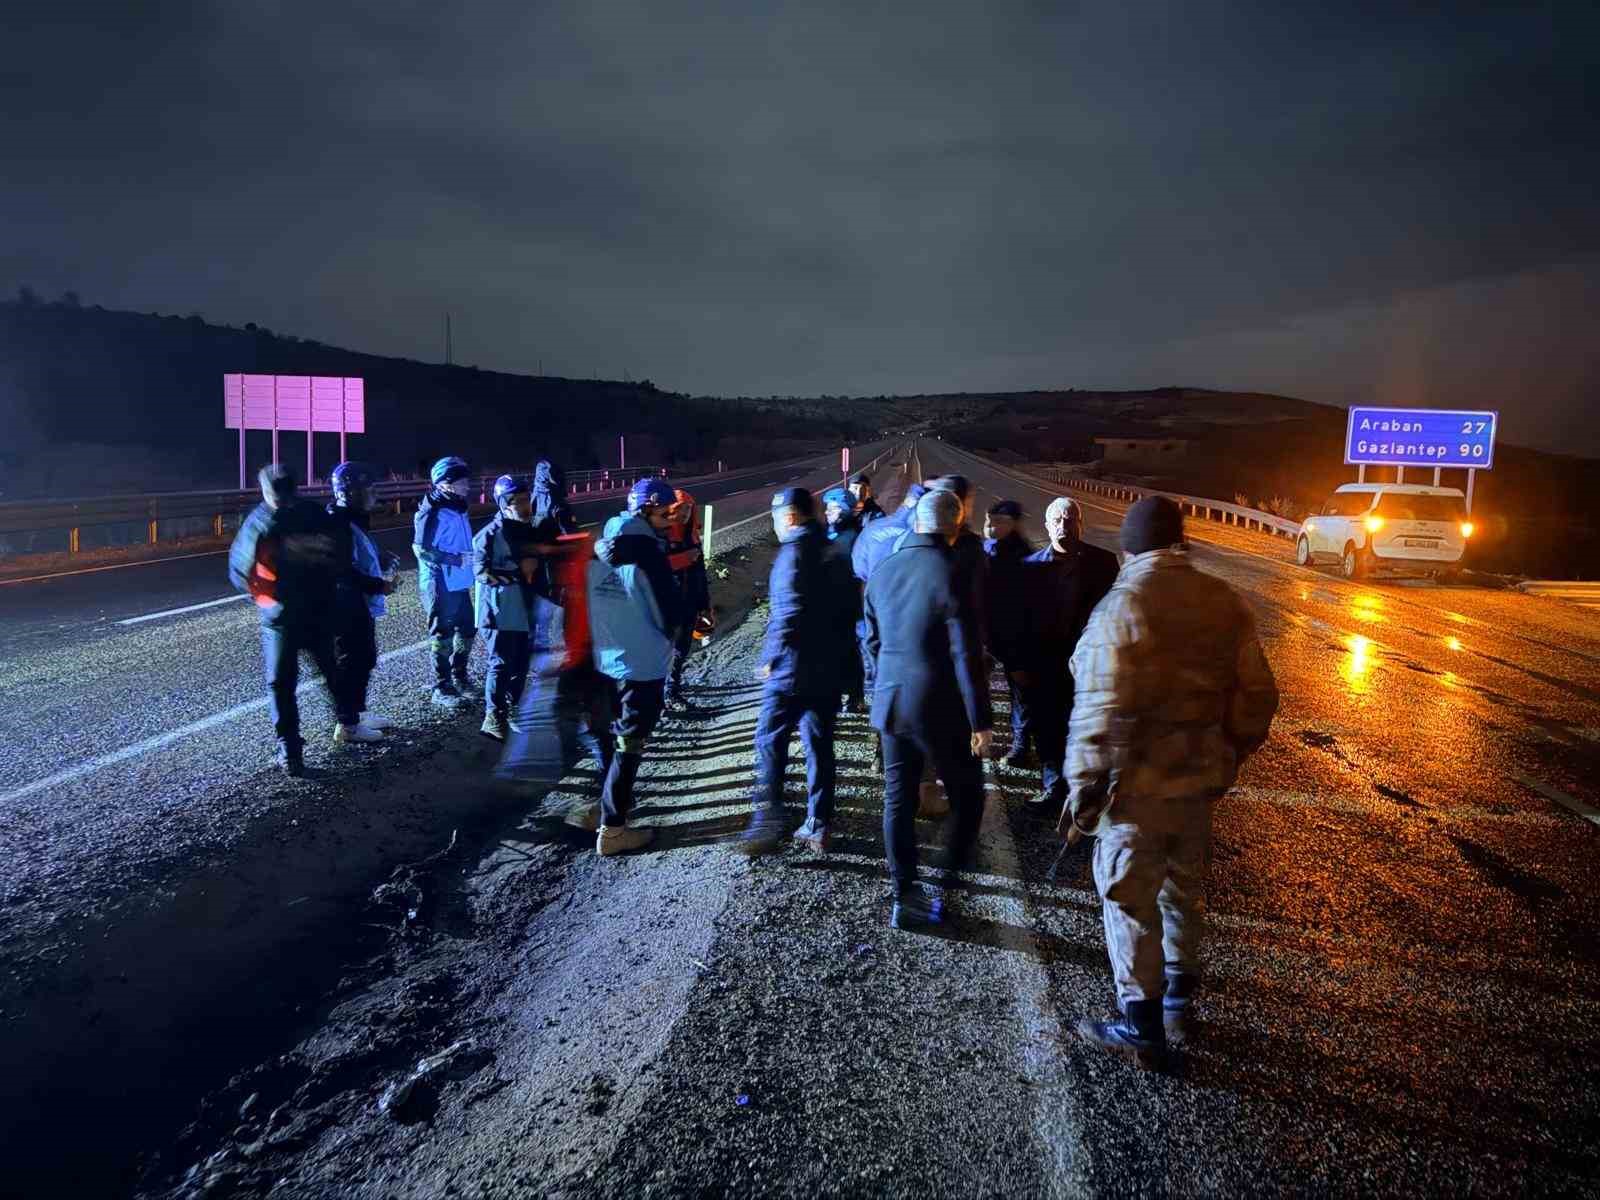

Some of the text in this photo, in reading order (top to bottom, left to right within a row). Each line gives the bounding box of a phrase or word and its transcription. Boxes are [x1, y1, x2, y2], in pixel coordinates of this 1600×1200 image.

[1360, 418, 1486, 434] Araban 27
[1358, 440, 1484, 458] Gaziantep 90
